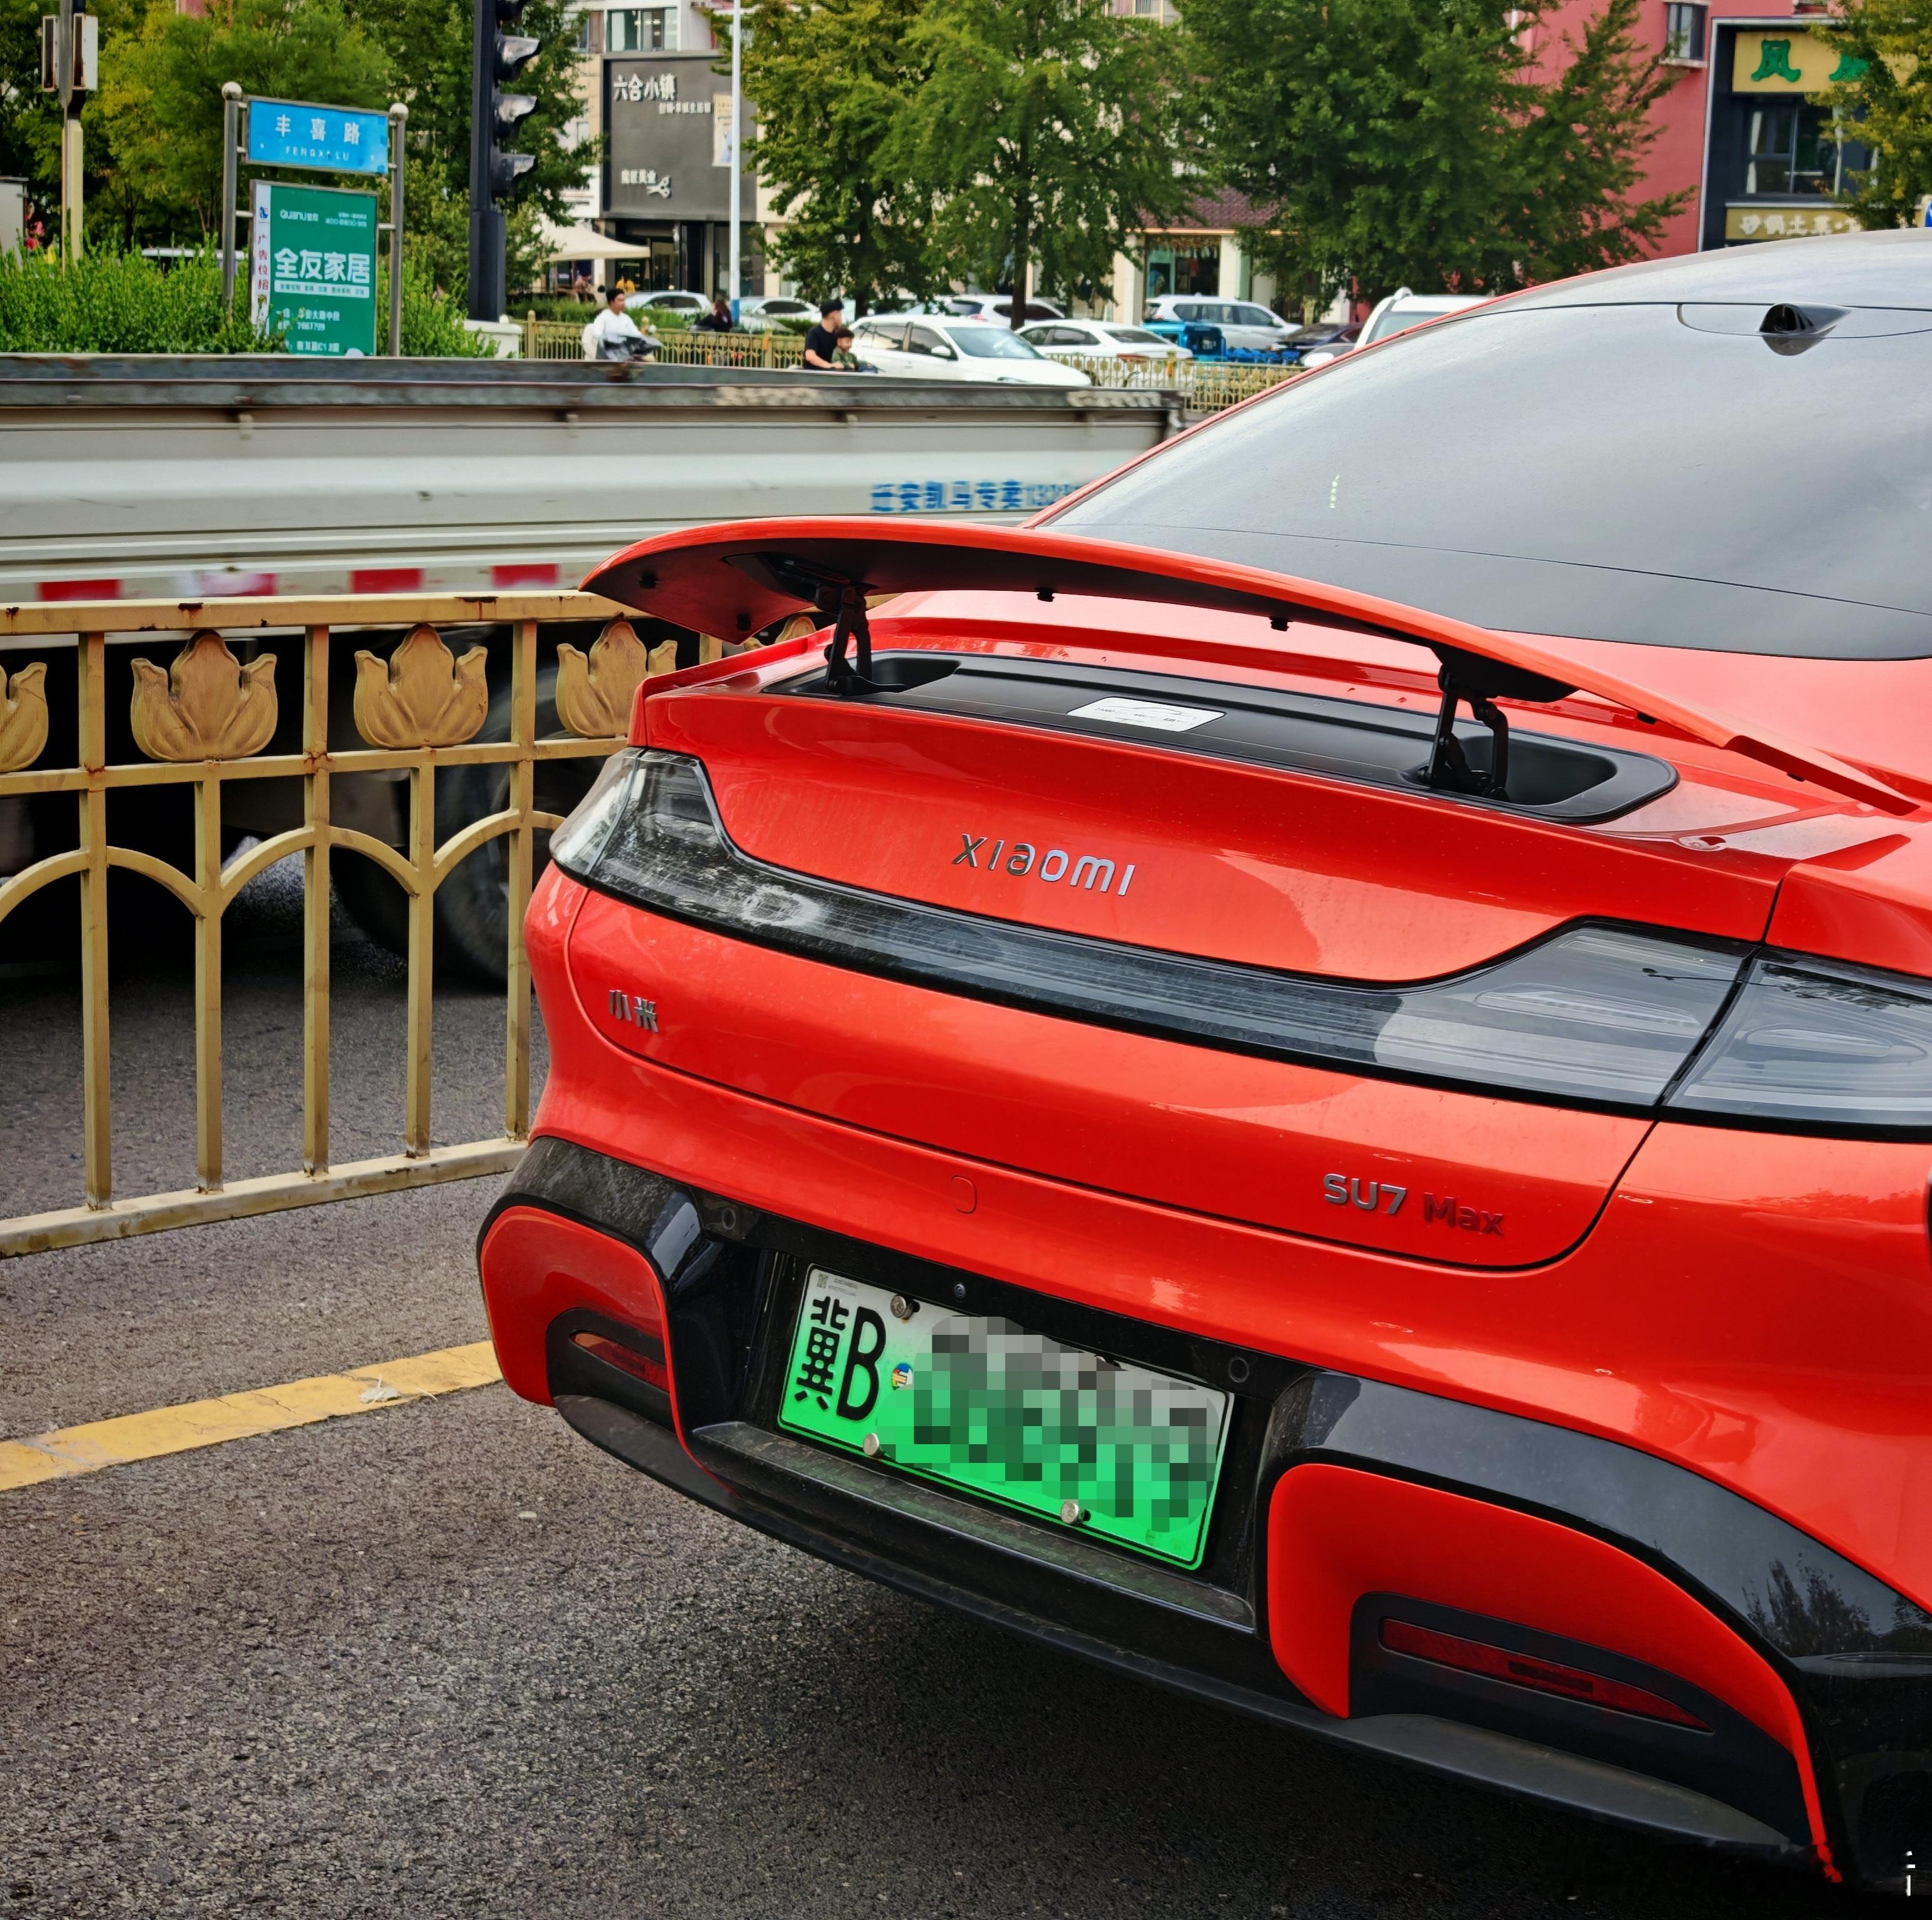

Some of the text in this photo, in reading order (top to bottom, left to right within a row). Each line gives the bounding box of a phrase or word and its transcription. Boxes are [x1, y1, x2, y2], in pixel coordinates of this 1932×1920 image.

[613, 73, 677, 101] 六合小镇
[275, 114, 360, 145] 丰喜路
[335, 151, 349, 161] LU
[274, 248, 370, 284] 全友家居
[870, 480, 1022, 511] 迁安凯马专卖
[608, 989, 660, 1033] 小米
[1323, 1173, 1504, 1235] SU7 Max
[794, 1295, 887, 1422] 冀B
